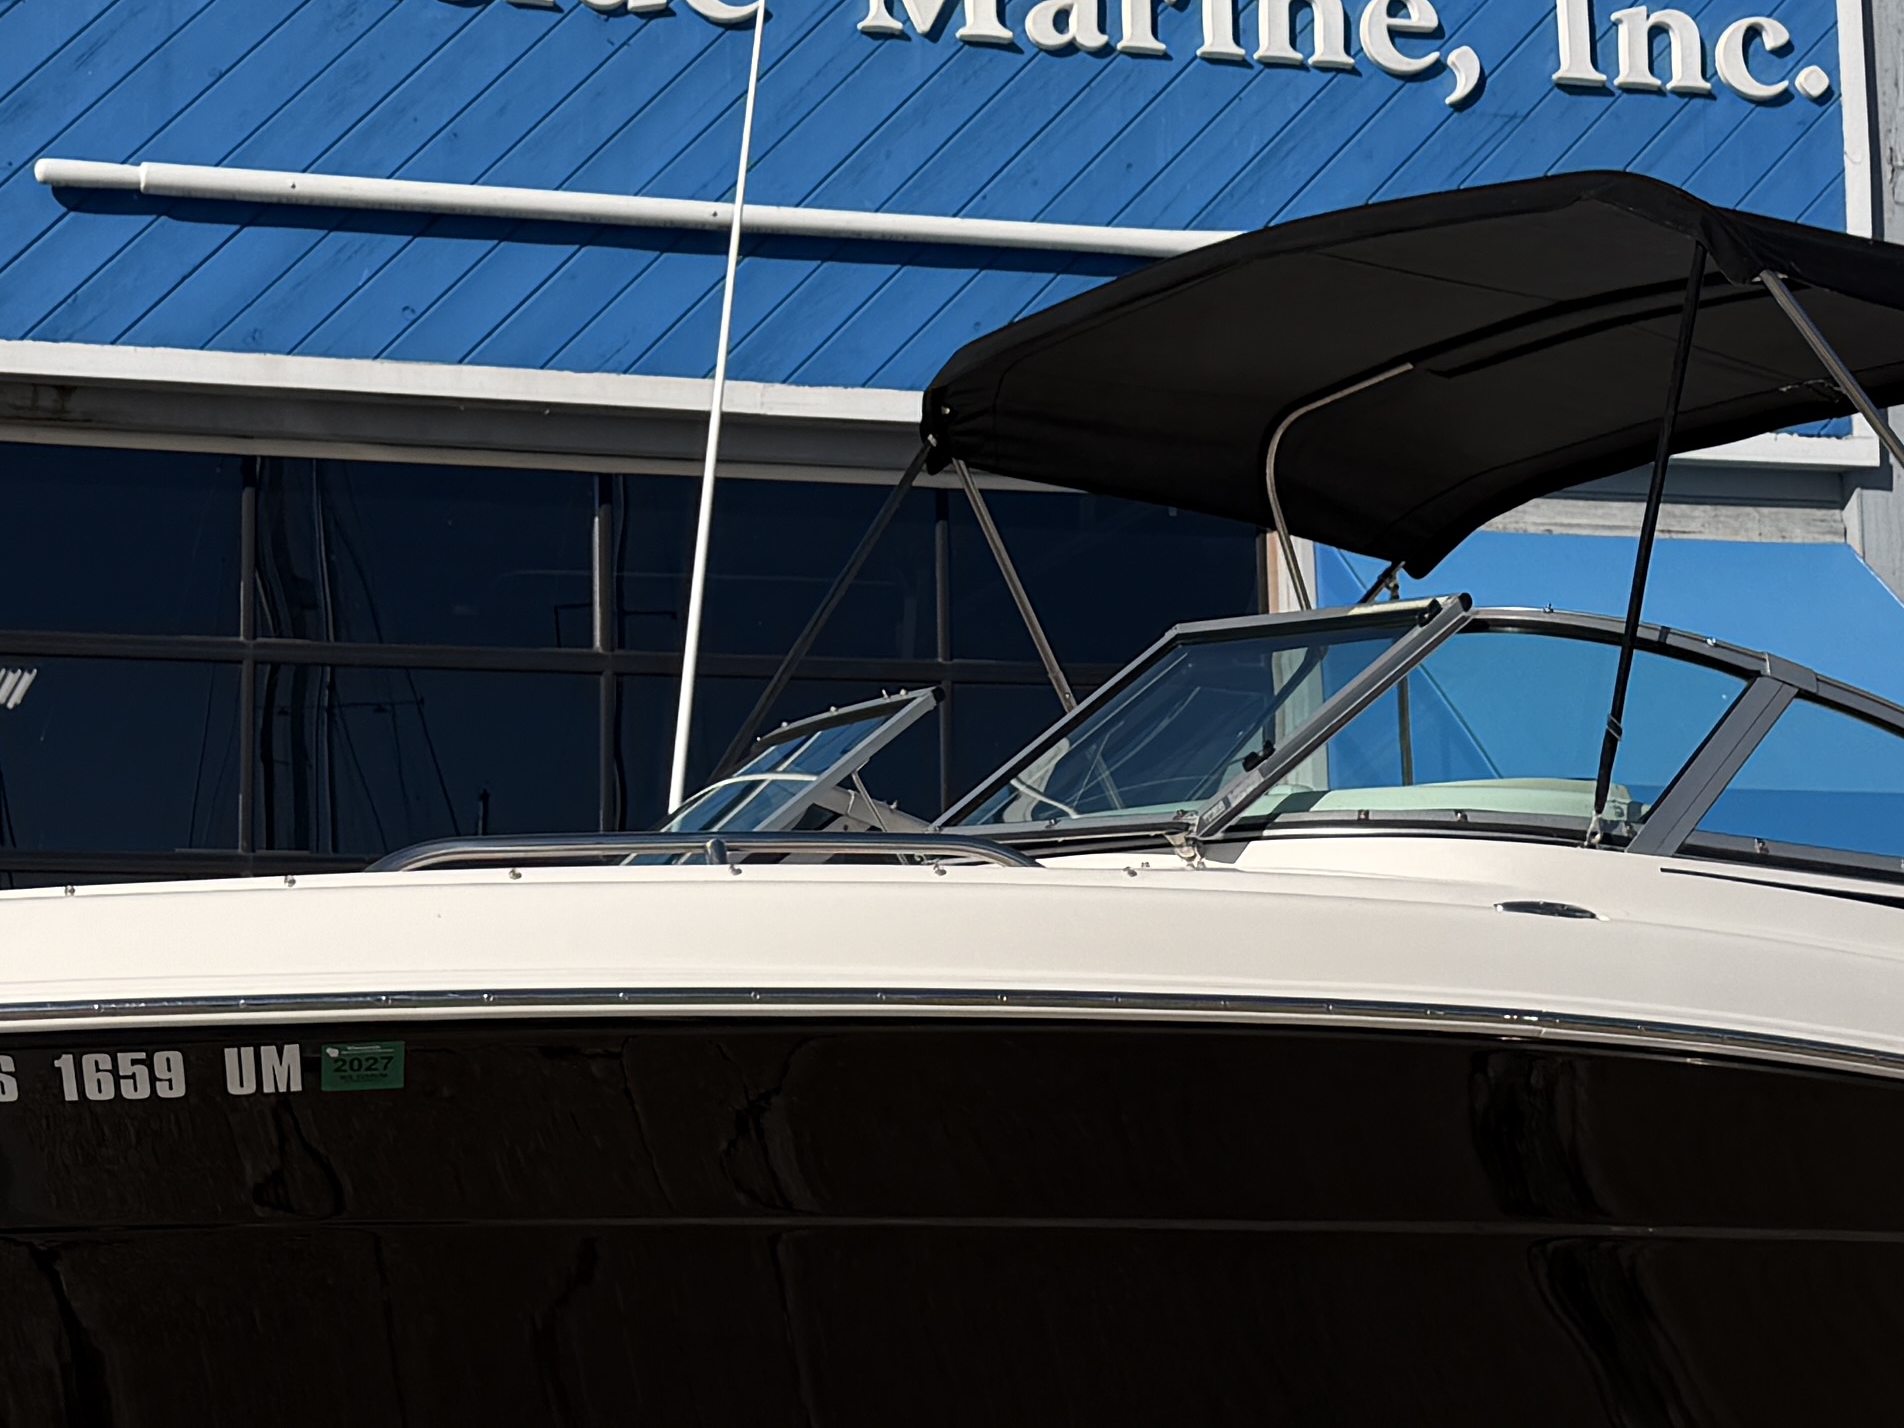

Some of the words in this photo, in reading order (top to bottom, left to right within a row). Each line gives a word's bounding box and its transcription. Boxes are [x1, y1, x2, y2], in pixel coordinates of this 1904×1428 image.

[54, 1051, 186, 1101] 1659
[224, 1044, 302, 1096] UM
[333, 1055, 394, 1073] 2027
